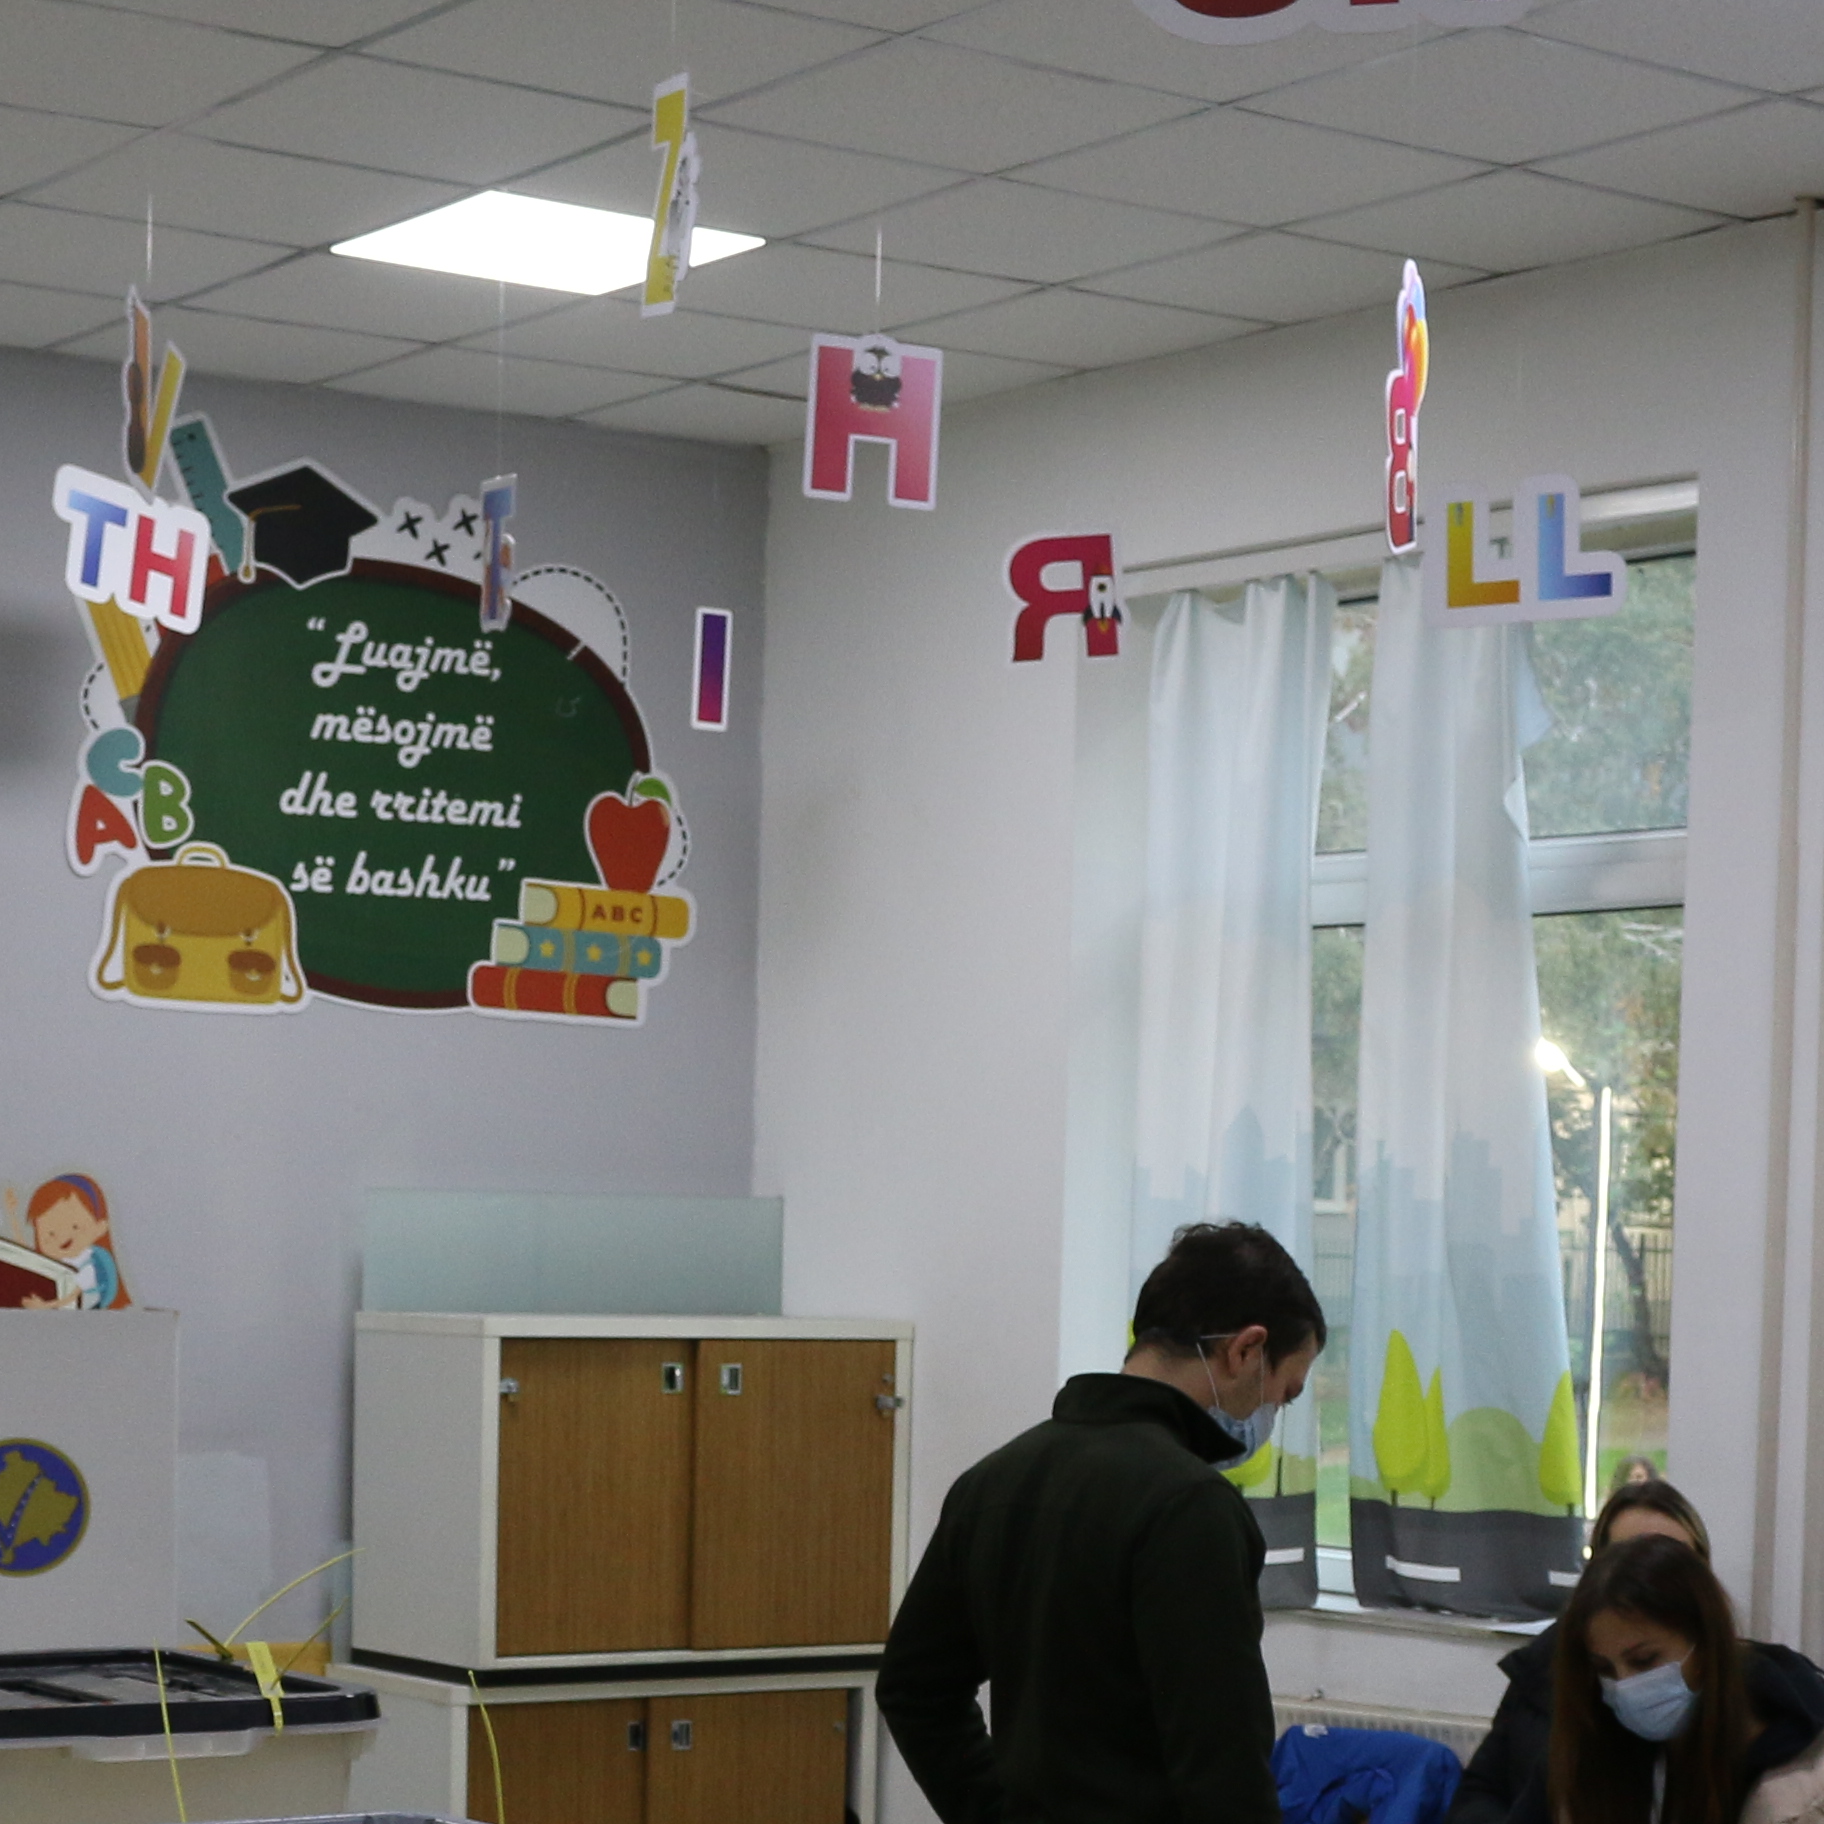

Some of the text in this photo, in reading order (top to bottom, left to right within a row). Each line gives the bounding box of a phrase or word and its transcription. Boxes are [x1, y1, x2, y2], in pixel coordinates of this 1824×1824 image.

[810, 345, 938, 502] H
[67, 486, 196, 620] TH
[1447, 492, 1613, 609] LL
[310, 705, 495, 769] mësojmë
[279, 770, 523, 829] dhe rritemi
[289, 856, 335, 893] së
[592, 904, 643, 924] ABC
